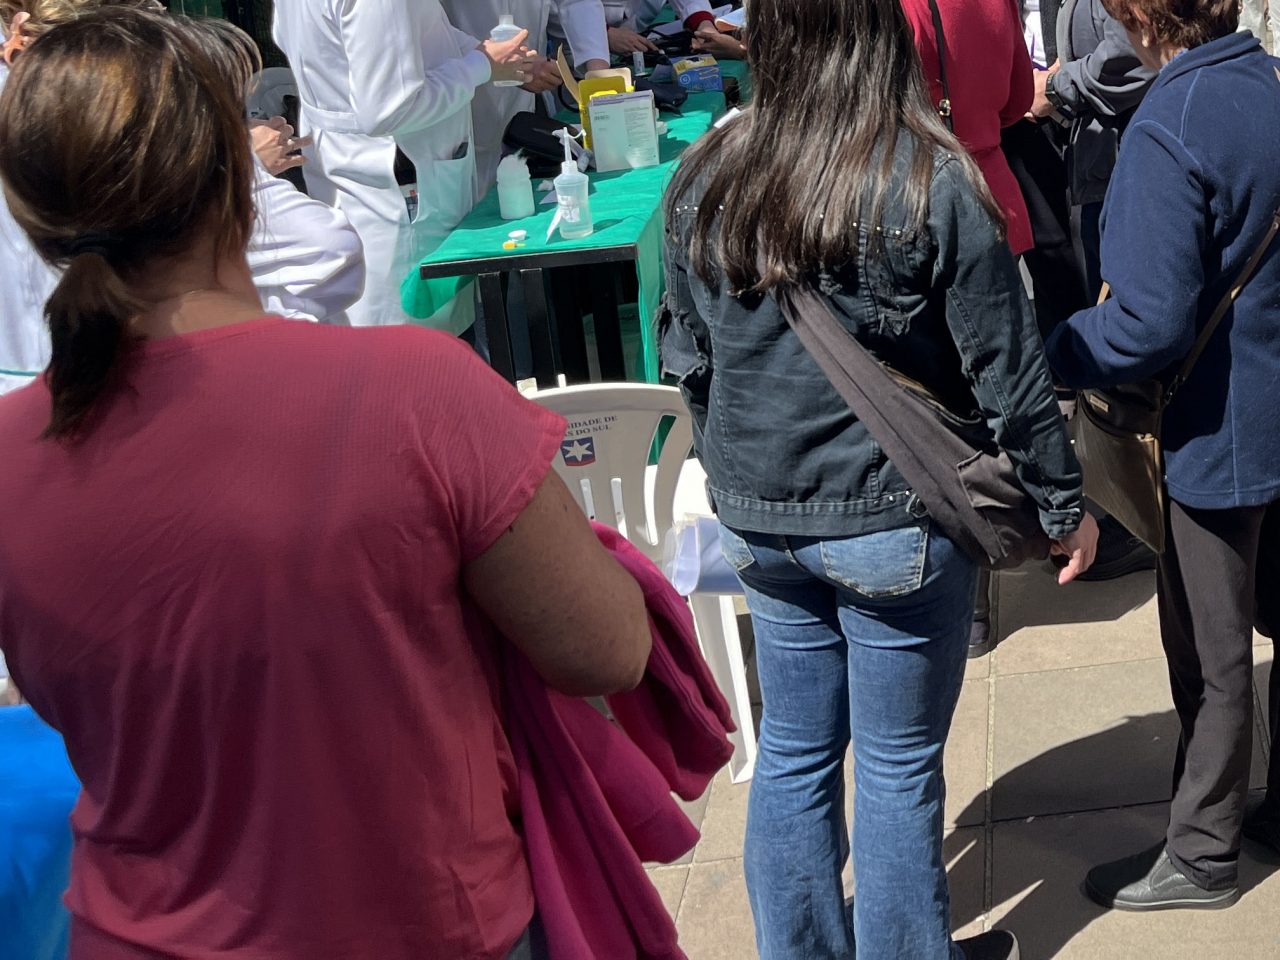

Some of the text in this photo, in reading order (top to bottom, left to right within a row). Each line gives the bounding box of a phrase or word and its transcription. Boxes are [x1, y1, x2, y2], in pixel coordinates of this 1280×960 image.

[604, 415, 617, 423] DE
[576, 428, 590, 436] DO
[592, 424, 612, 433] SUL
